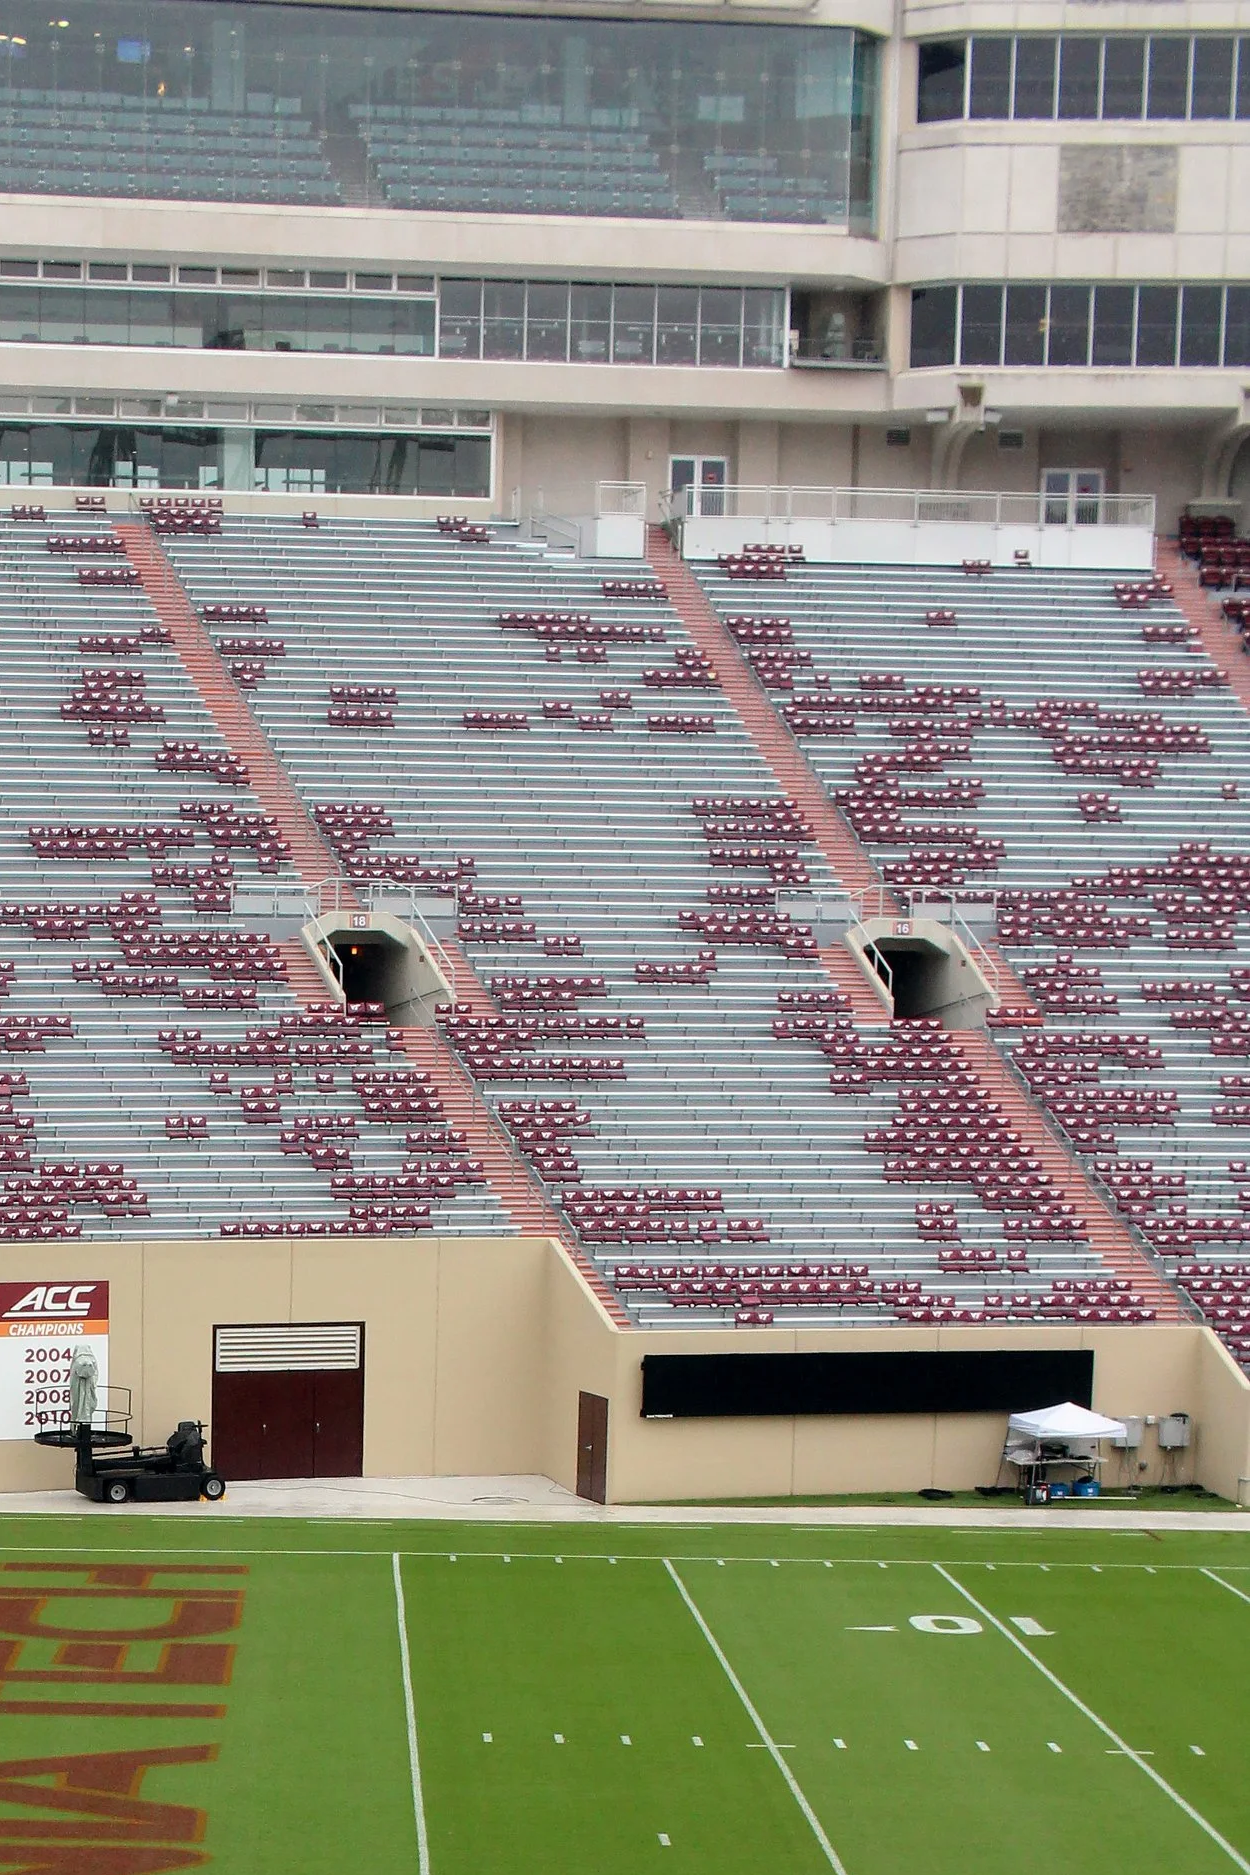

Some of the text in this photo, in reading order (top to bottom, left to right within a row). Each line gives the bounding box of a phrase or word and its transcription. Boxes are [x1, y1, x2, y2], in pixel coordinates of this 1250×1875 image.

[353, 916, 366, 926] 18
[896, 923, 909, 933] 16
[7, 1285, 97, 1313] ACC
[9, 1322, 84, 1336] CHAMPIONS
[24, 1347, 72, 1362] 2004
[24, 1369, 71, 1384] 2007
[24, 1390, 71, 1404] 2008
[24, 1411, 71, 1425] 2010
